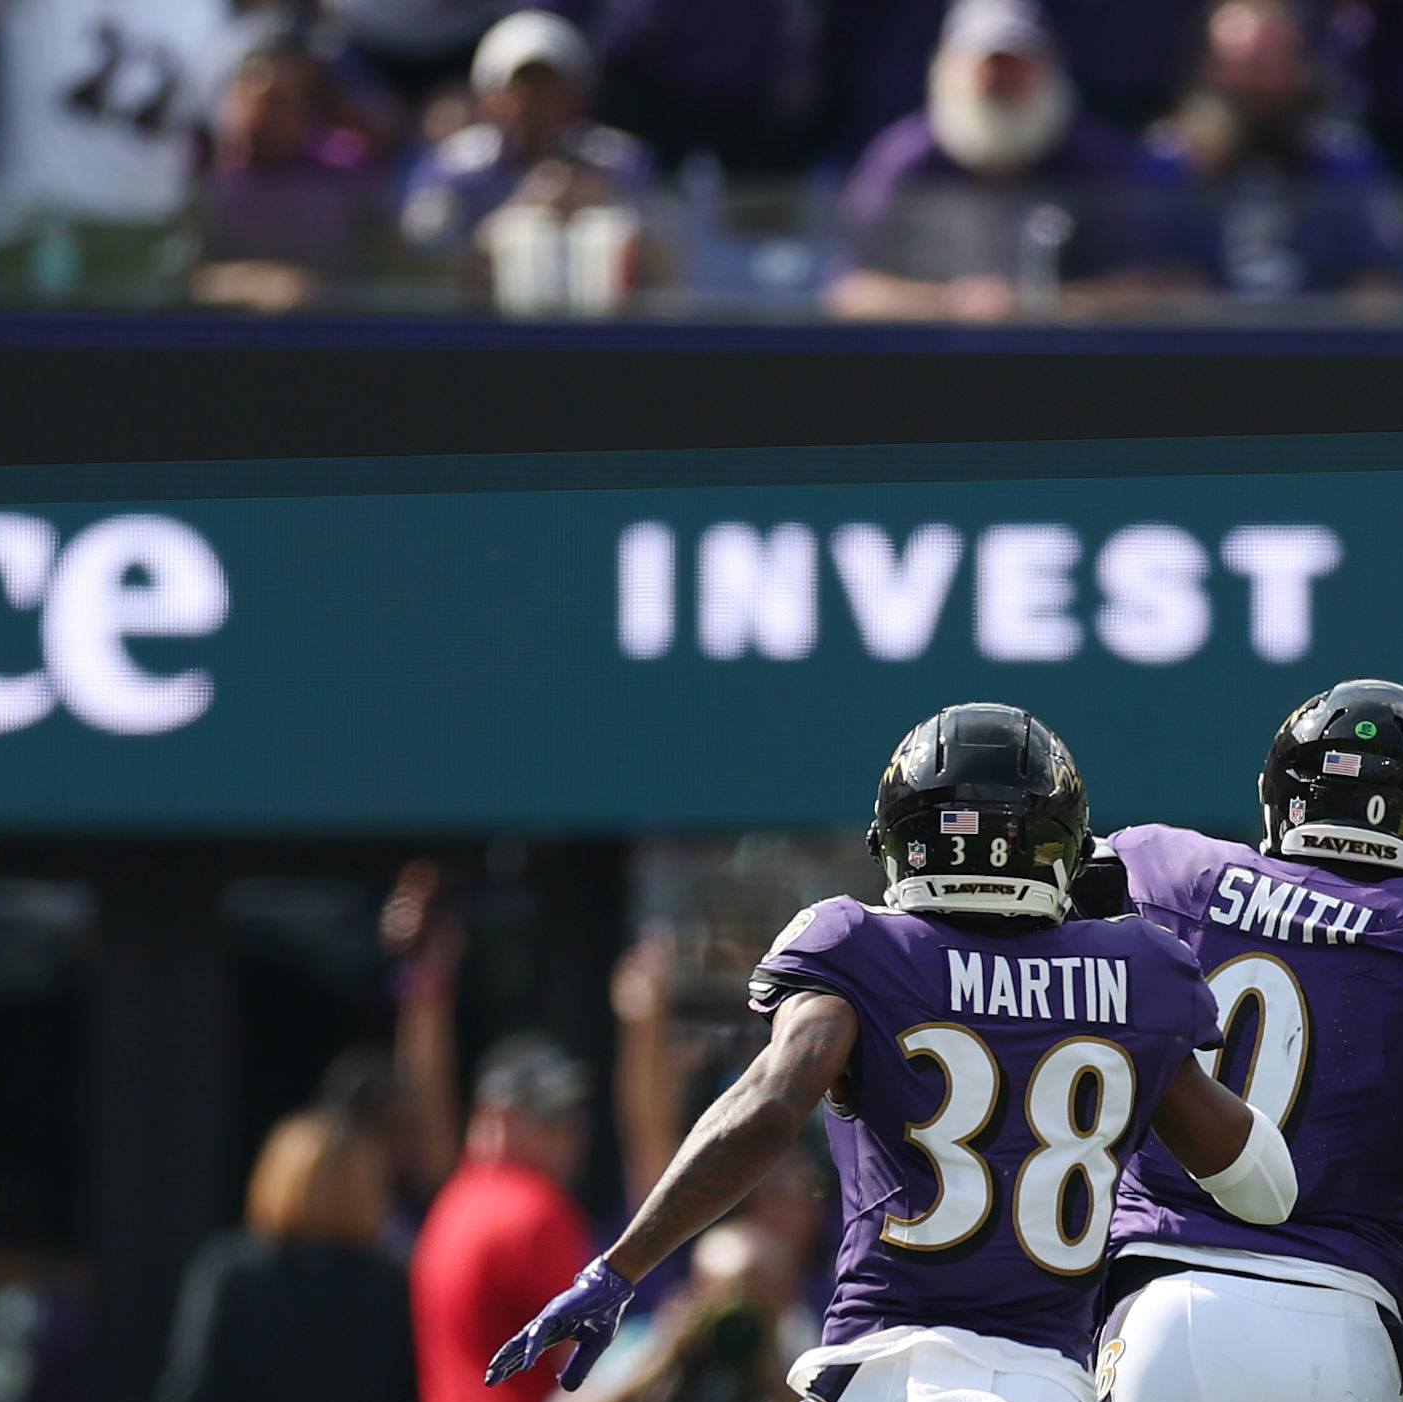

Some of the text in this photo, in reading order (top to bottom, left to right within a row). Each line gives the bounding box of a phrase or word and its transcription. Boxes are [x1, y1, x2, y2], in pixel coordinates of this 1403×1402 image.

[616, 520, 1343, 666] INVEST
[1301, 834, 1398, 860] RAVENS
[1366, 794, 1386, 826] 0
[941, 882, 1017, 896] RAVENS
[1208, 867, 1374, 945] SMITH
[947, 948, 1127, 1025] MARTIN
[879, 1021, 1138, 1277] 38
